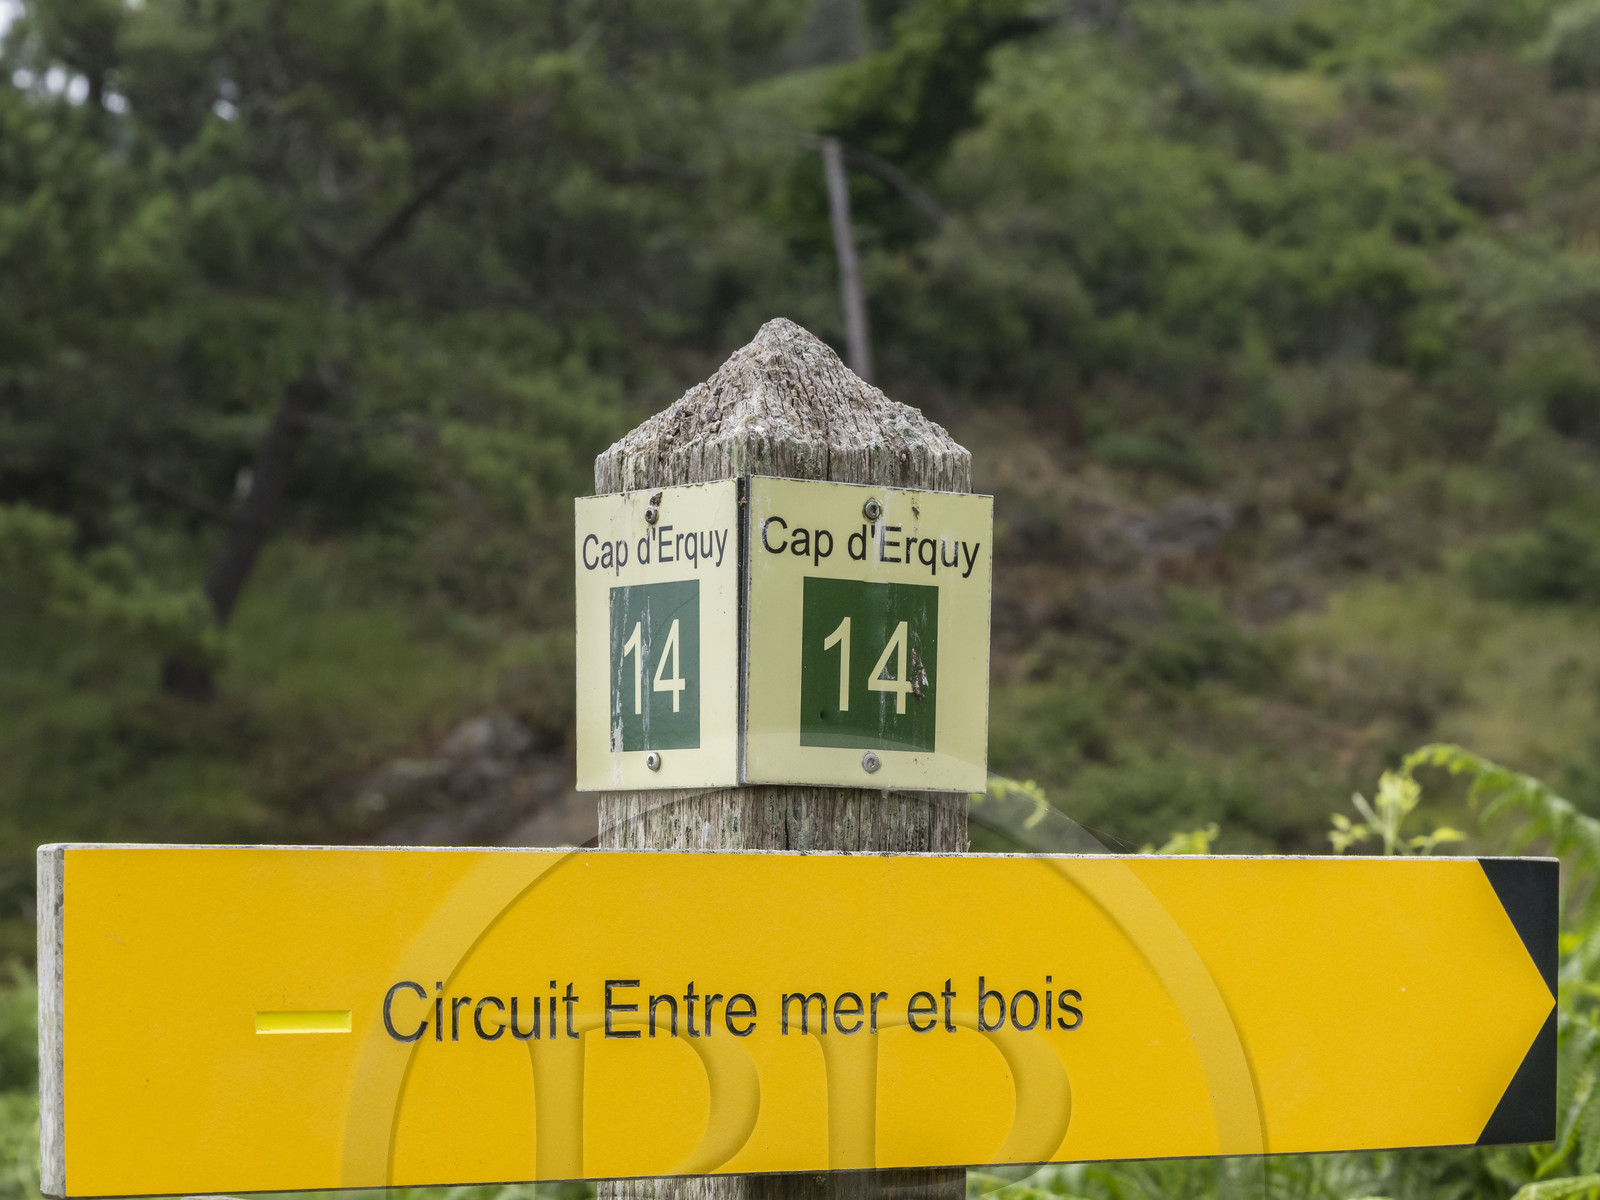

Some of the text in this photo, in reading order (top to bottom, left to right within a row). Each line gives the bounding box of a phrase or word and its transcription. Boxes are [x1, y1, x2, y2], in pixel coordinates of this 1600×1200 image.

[583, 525, 728, 576] Cap d'Erquy
[762, 516, 980, 578] Cap d'Erquy
[623, 618, 686, 715] 14
[823, 616, 913, 715] 14
[382, 975, 1084, 1043] Circuit Entre mer et bois
